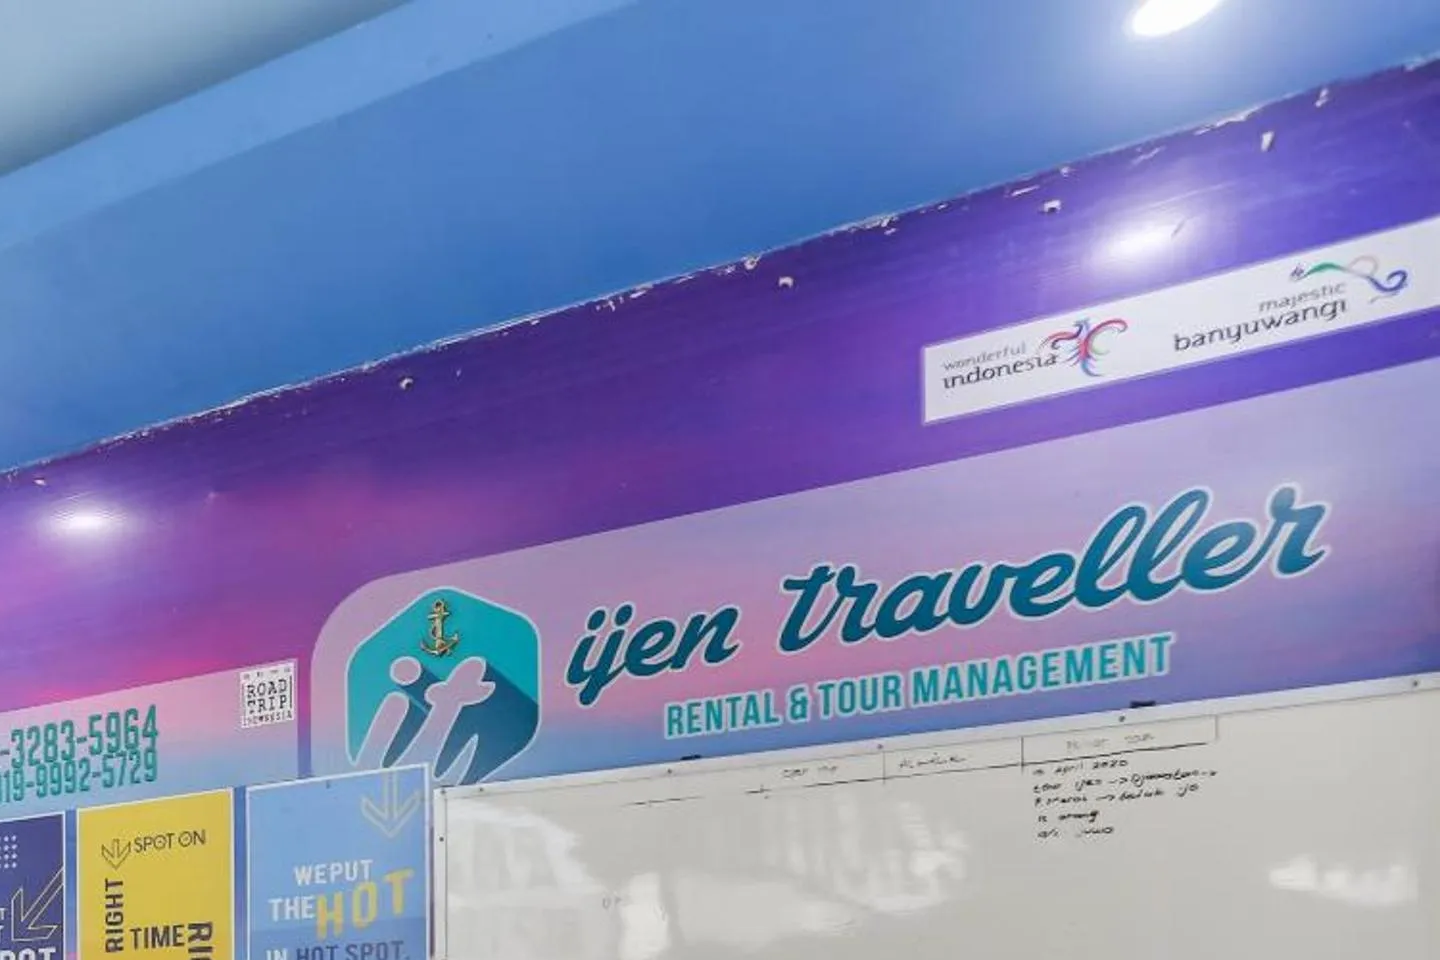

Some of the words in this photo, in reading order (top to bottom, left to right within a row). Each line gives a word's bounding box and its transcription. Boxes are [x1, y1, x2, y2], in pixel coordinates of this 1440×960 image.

[1258, 282, 1347, 313] majestic
[1174, 299, 1347, 353] banyuwangi
[942, 353, 1059, 390] indonesia
[943, 342, 1028, 372] wonderful
[564, 602, 741, 707] ijen
[780, 485, 1329, 654] traveller
[664, 691, 784, 740] RENTAL
[790, 687, 809, 723] &
[818, 677, 907, 719] TOUR
[911, 633, 1175, 711] MANAGEMENT
[134, 833, 176, 853] SPOT
[178, 829, 207, 848] ON
[294, 864, 327, 886] WE
[329, 859, 373, 883] PUT
[105, 878, 124, 953] RIGHT
[268, 895, 316, 922] THE
[316, 868, 415, 941] HOT
[130, 924, 186, 950] TIME
